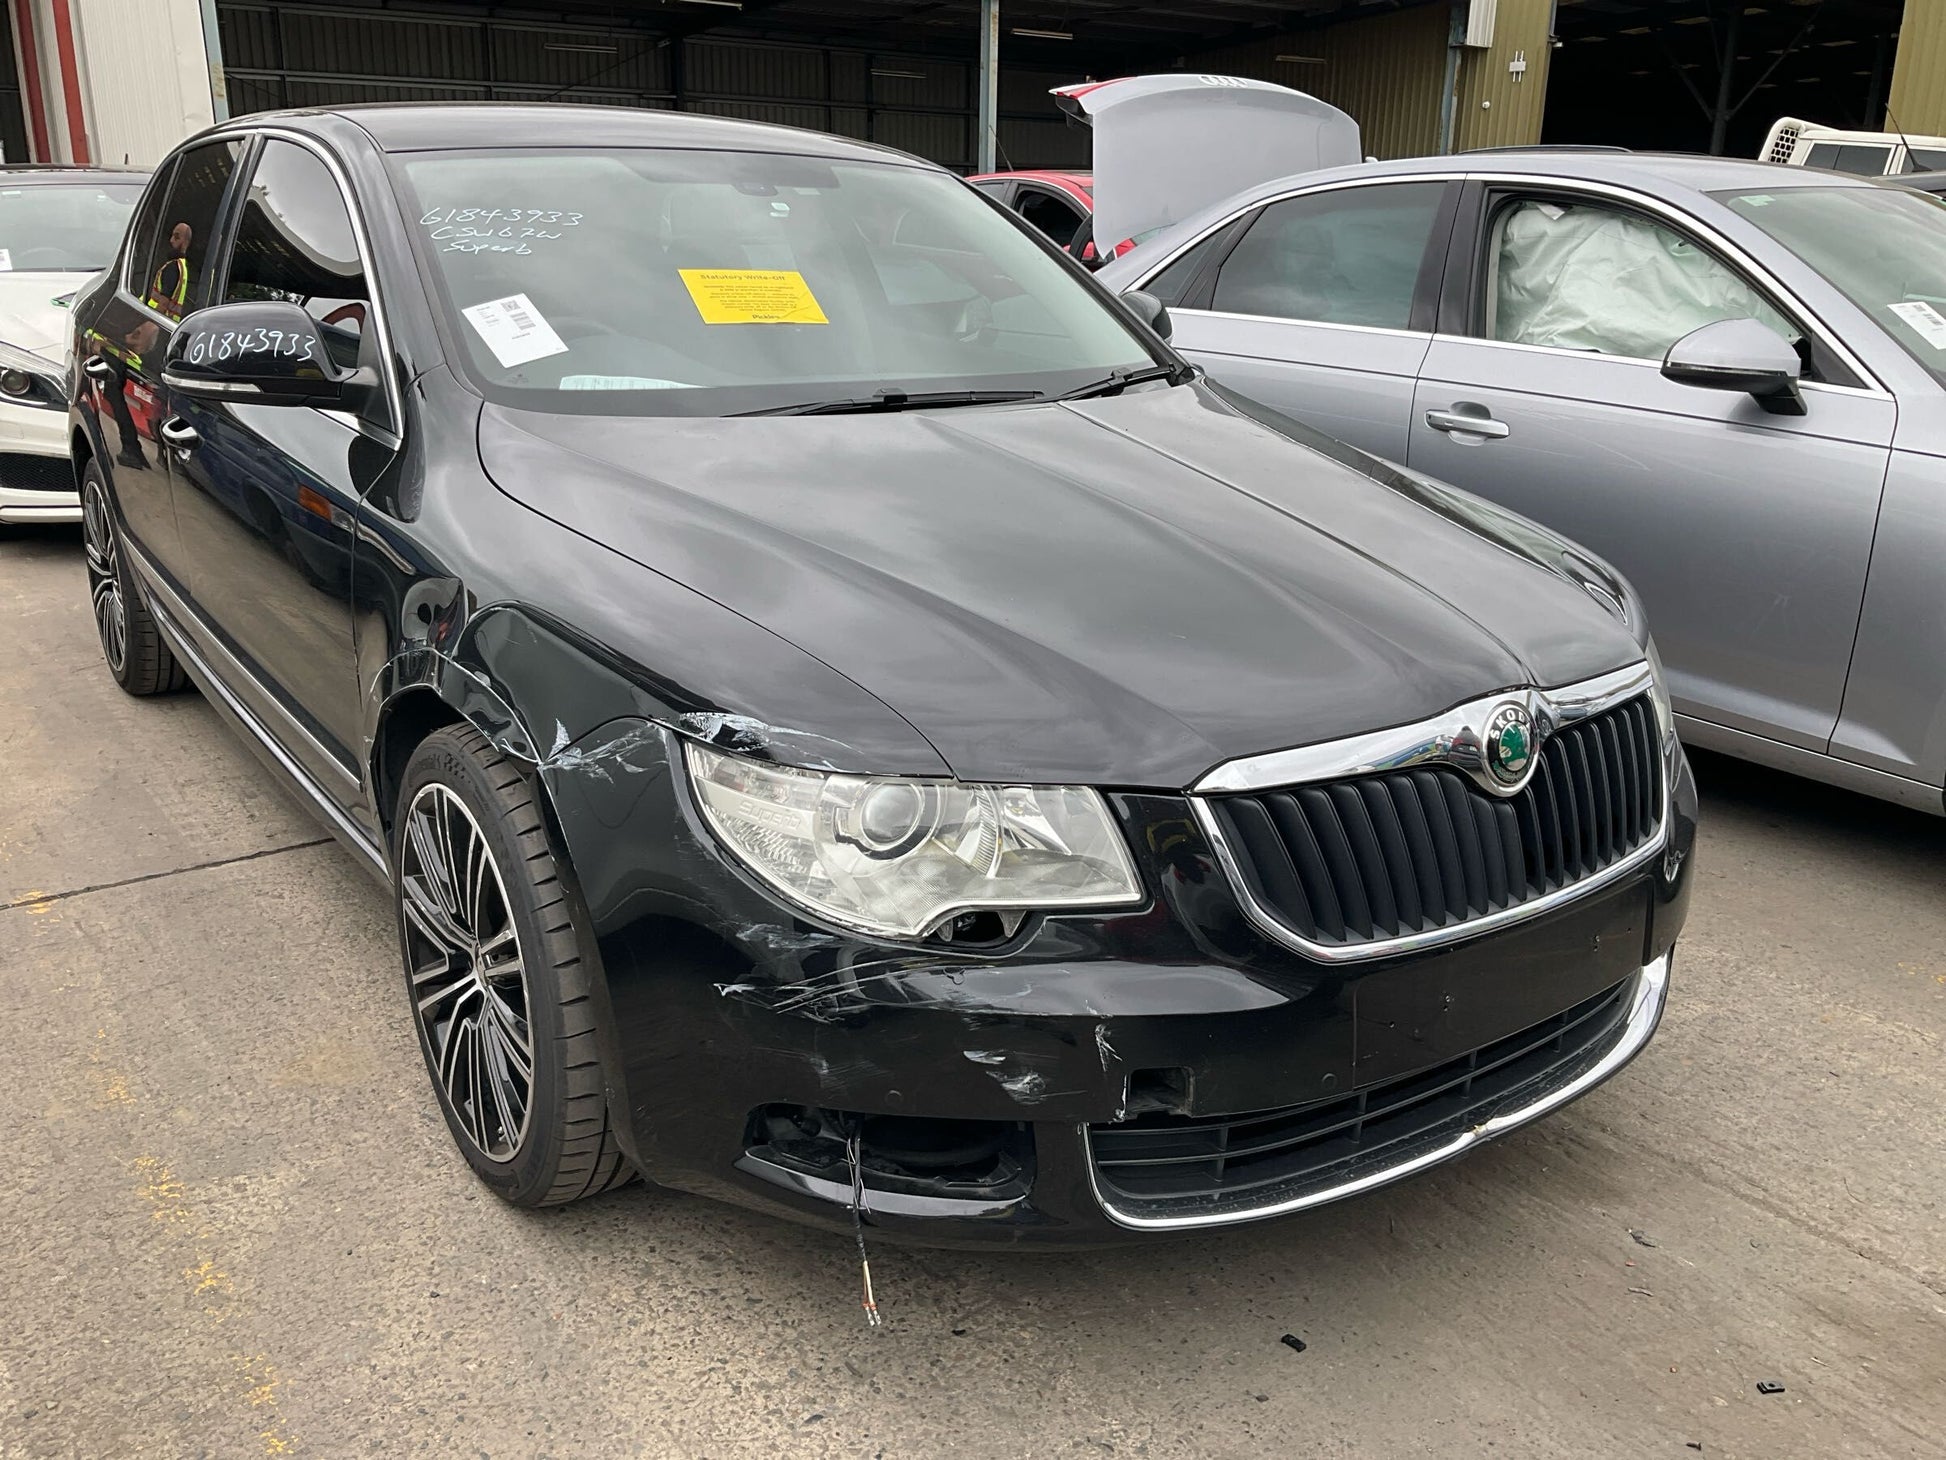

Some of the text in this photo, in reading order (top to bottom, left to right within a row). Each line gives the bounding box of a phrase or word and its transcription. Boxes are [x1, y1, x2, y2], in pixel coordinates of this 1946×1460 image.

[419, 207, 585, 226] 61843933
[442, 239, 533, 255] Superb
[189, 328, 317, 364] 61843933
